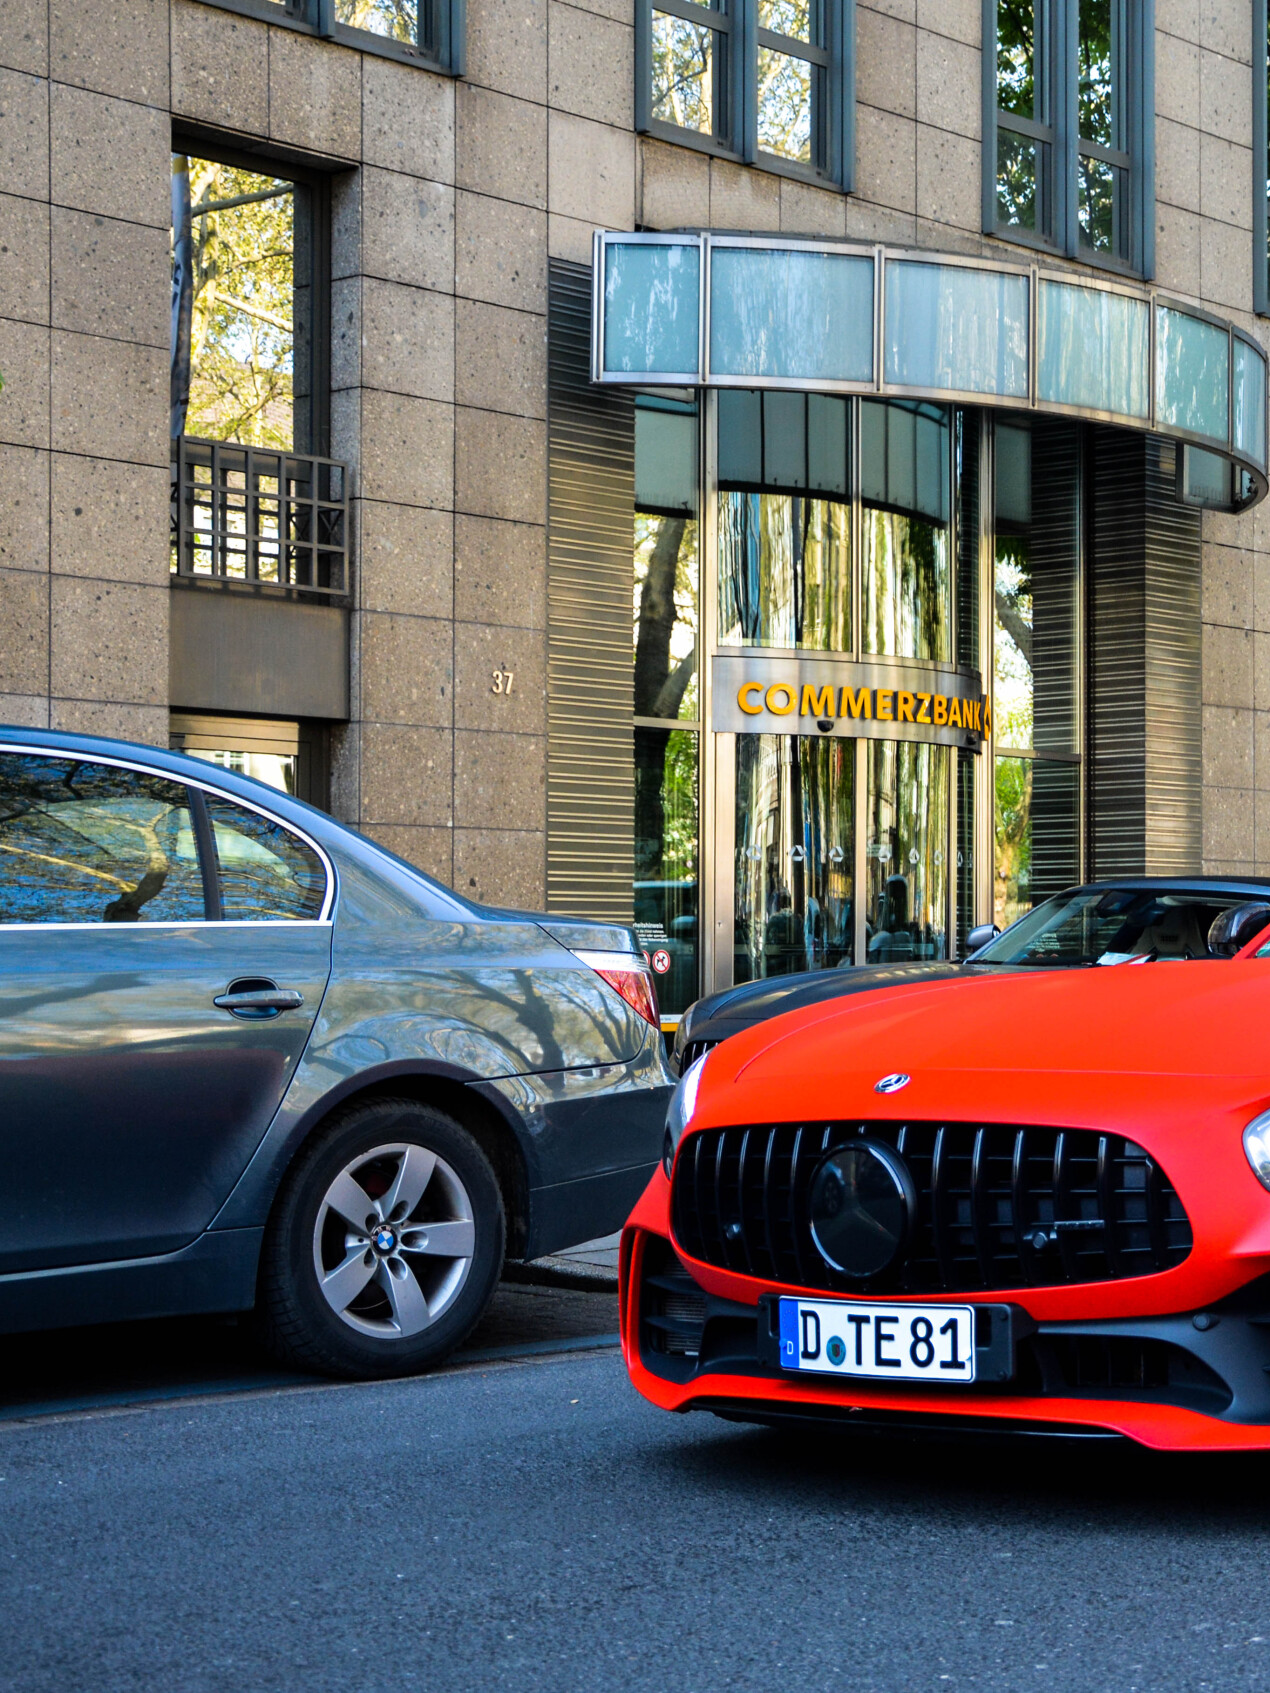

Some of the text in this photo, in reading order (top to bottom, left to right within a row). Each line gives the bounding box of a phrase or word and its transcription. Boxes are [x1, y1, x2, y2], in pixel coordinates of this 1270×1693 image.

[492, 670, 514, 695] 37
[737, 681, 982, 732] COMMERZBANK
[800, 1309, 821, 1360] D
